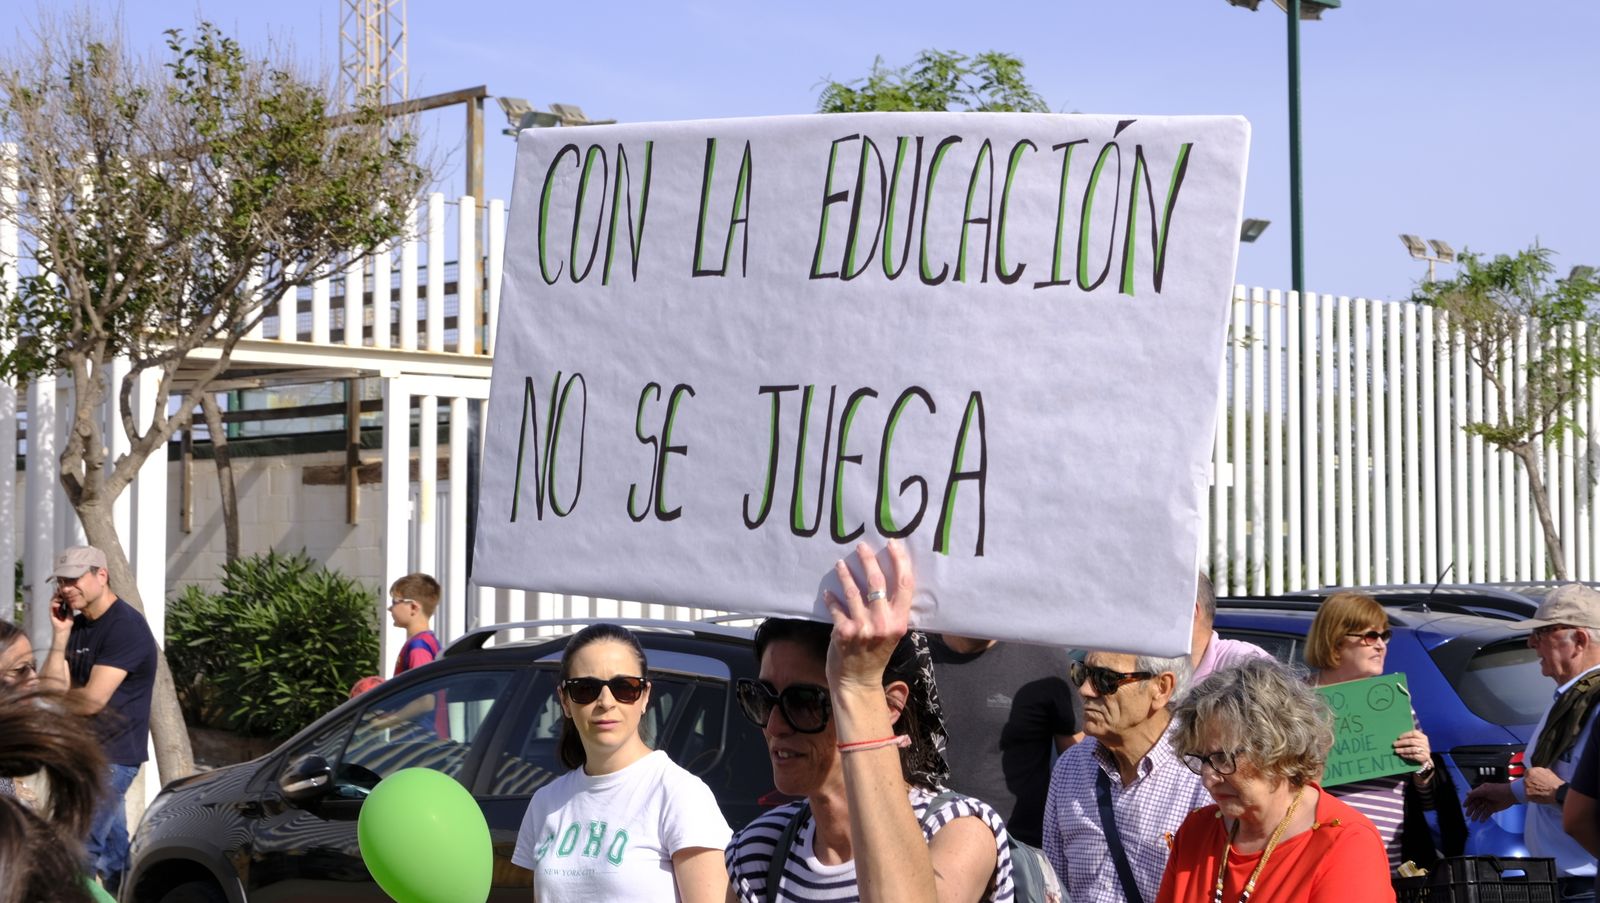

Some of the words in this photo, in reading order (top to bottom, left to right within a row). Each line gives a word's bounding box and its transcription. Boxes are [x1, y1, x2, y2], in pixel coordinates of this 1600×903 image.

[537, 140, 654, 286] CON
[692, 137, 752, 278] LA
[809, 119, 1194, 297] EDUCACIÓN
[510, 370, 587, 523] NO
[627, 381, 696, 523] SE
[742, 384, 987, 558] JUEGA
[544, 867, 559, 876] NEW
[562, 868, 582, 877] YORK
